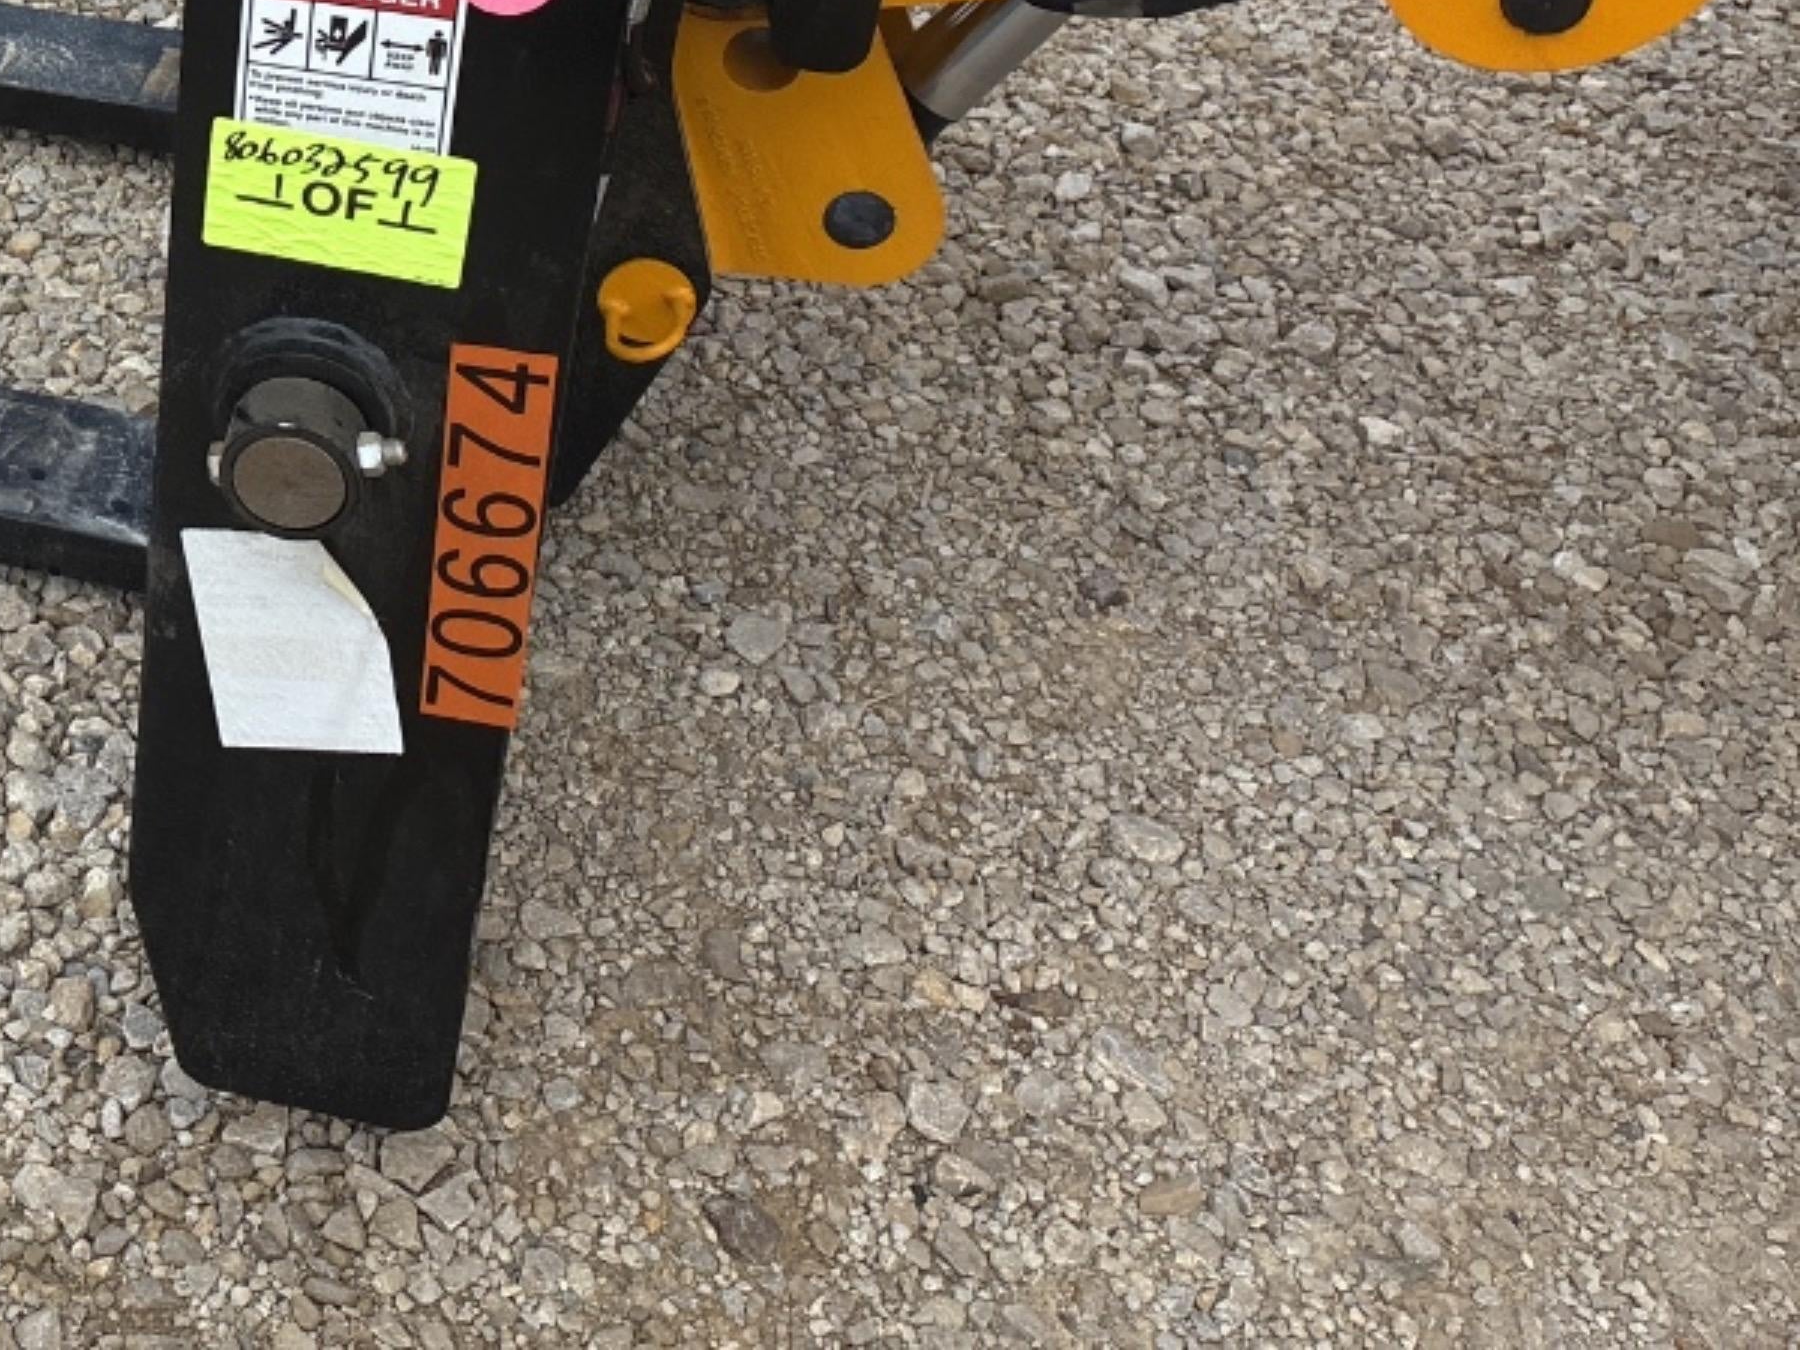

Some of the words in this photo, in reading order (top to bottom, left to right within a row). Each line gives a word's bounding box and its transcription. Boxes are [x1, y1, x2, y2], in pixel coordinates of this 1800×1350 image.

[223, 130, 440, 208] 806032599
[301, 180, 378, 220] OF
[425, 363, 550, 708] 706674
